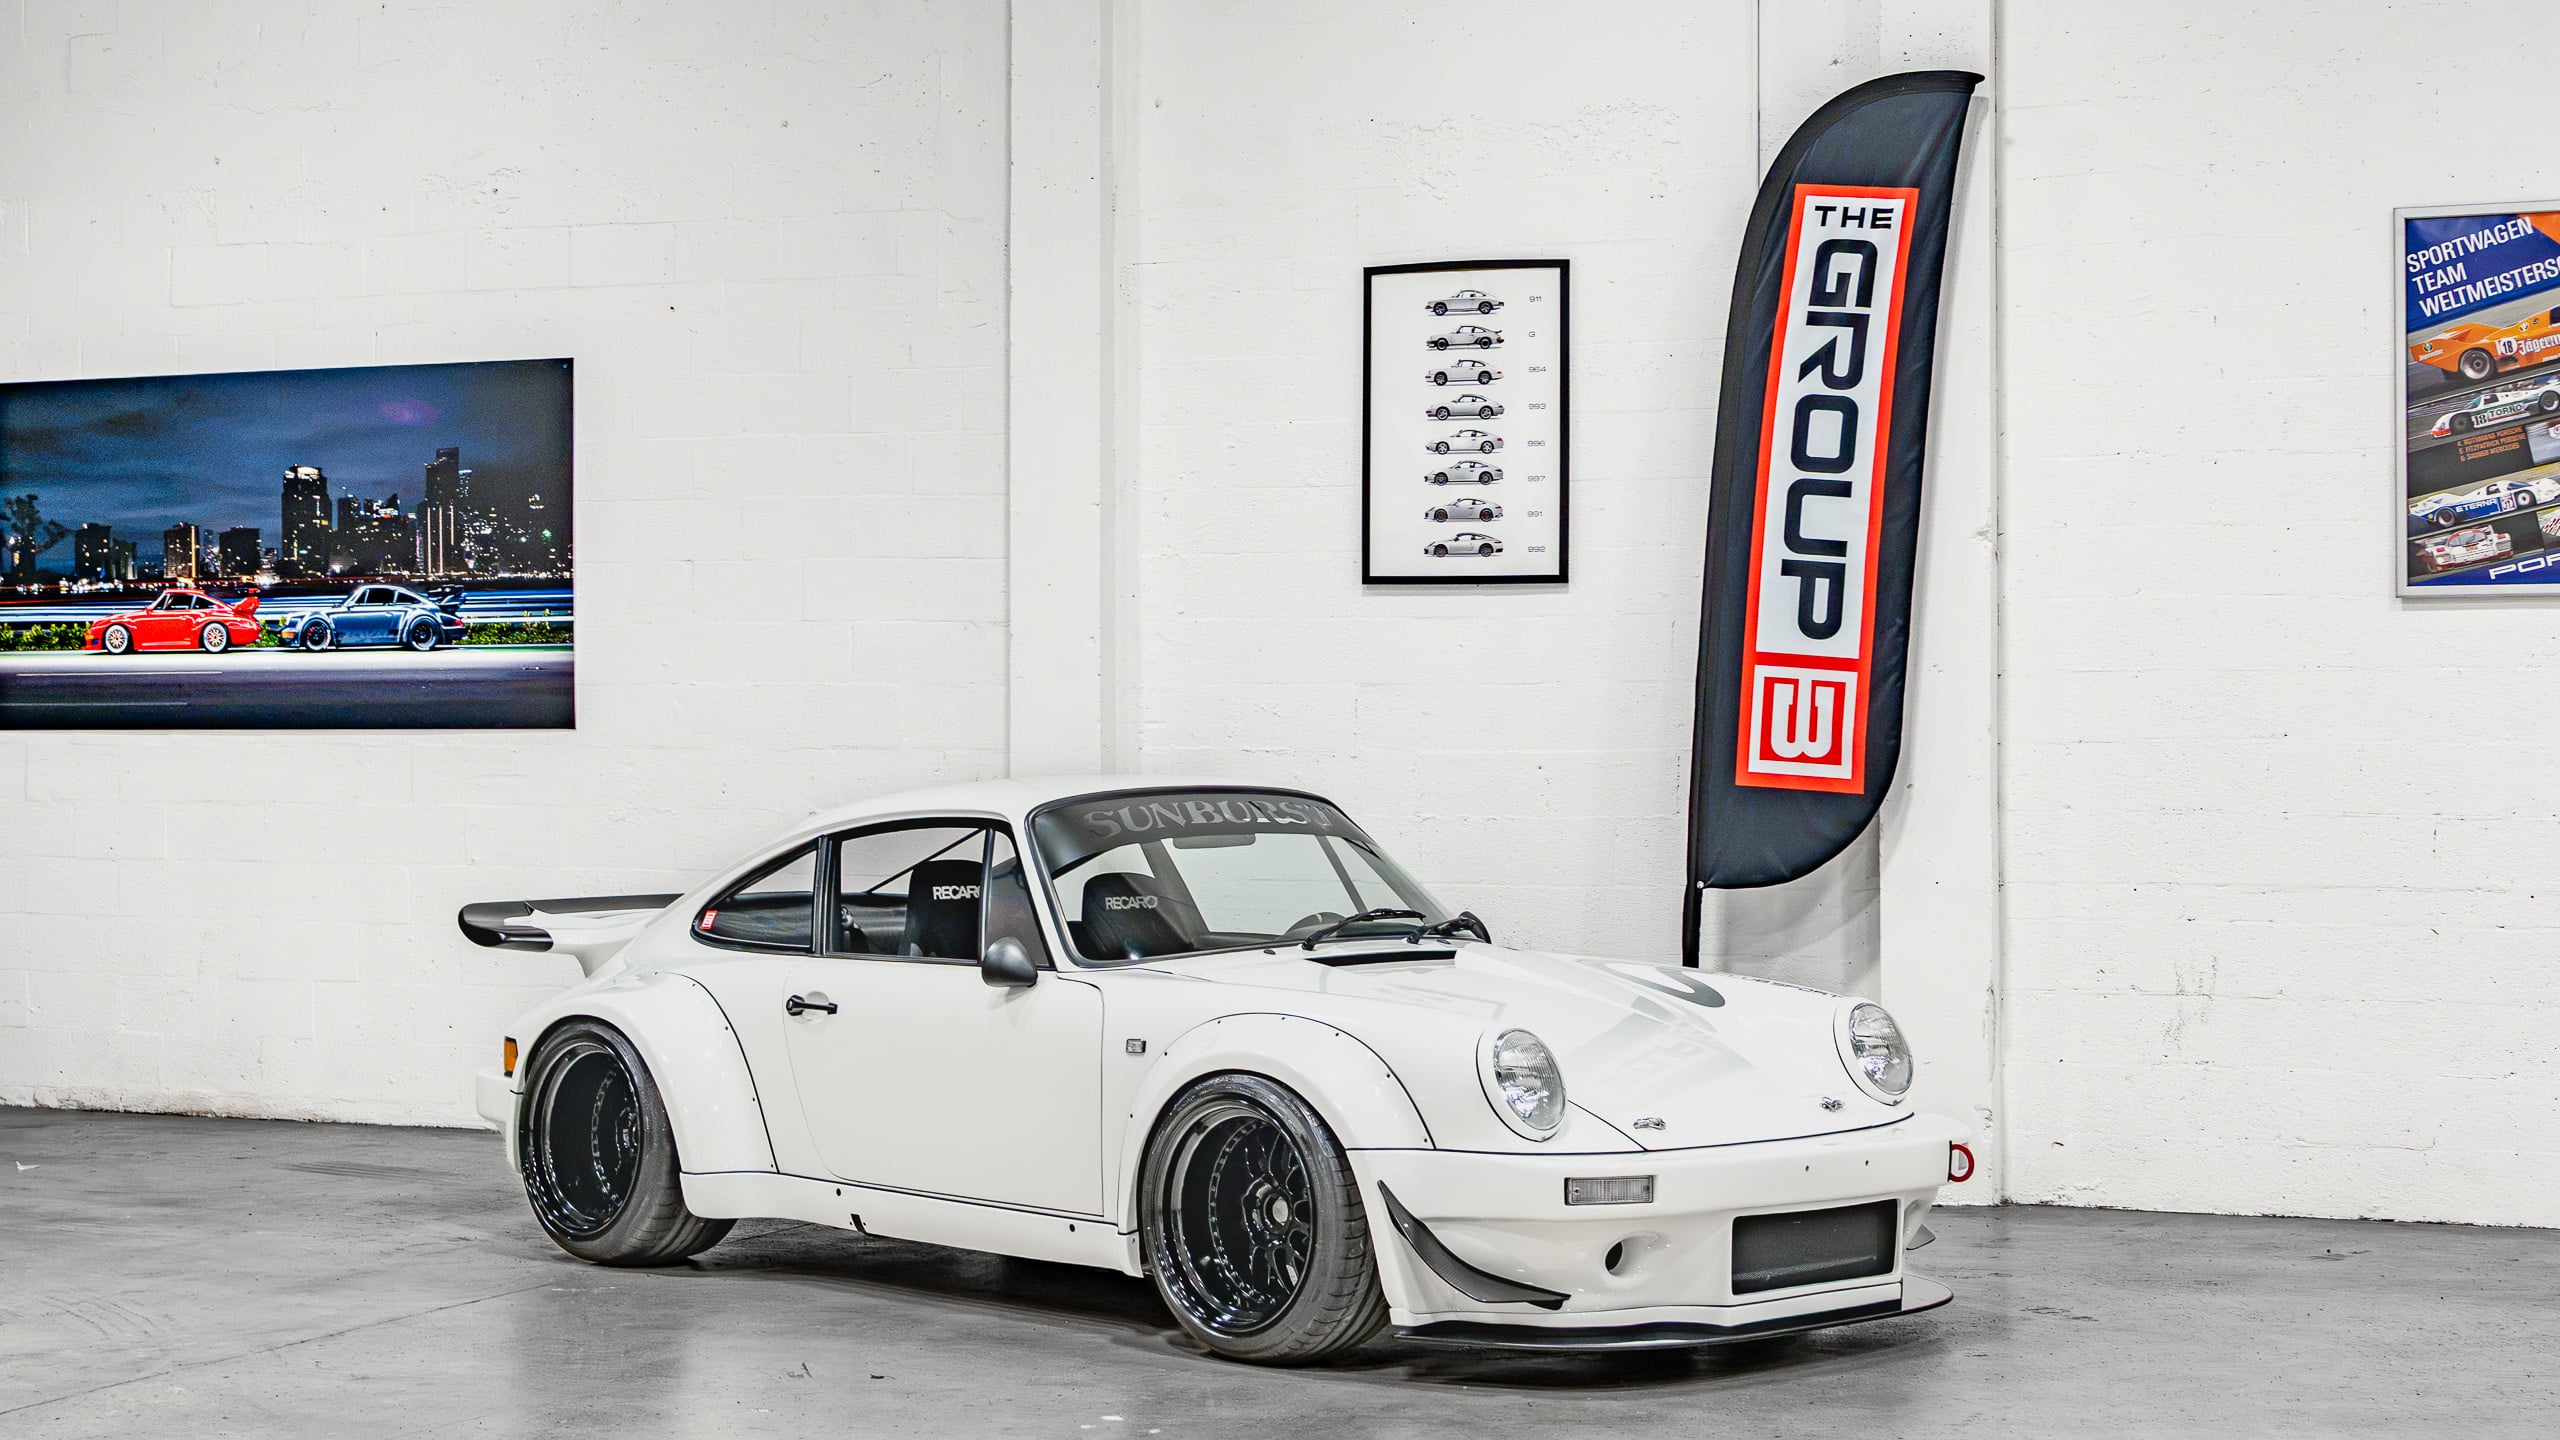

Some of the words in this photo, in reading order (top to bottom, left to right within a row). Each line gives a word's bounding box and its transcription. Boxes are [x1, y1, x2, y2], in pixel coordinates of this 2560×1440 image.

[1814, 205, 1895, 230] THE
[2406, 216, 2534, 273] SPORTWAGEN
[2411, 262, 2468, 295] TEAM
[1529, 295, 1542, 303] 911
[1528, 330, 1536, 338] G
[2502, 340, 2514, 354] 18
[2474, 414, 2487, 426] 18
[2489, 404, 2523, 417] TORNO
[1780, 238, 1878, 640] GROUP
[2455, 498, 2498, 513] ETERNA
[1083, 799, 1334, 840] SUNBURST
[932, 884, 980, 900] RECAR
[1104, 894, 1159, 910] RECARO
